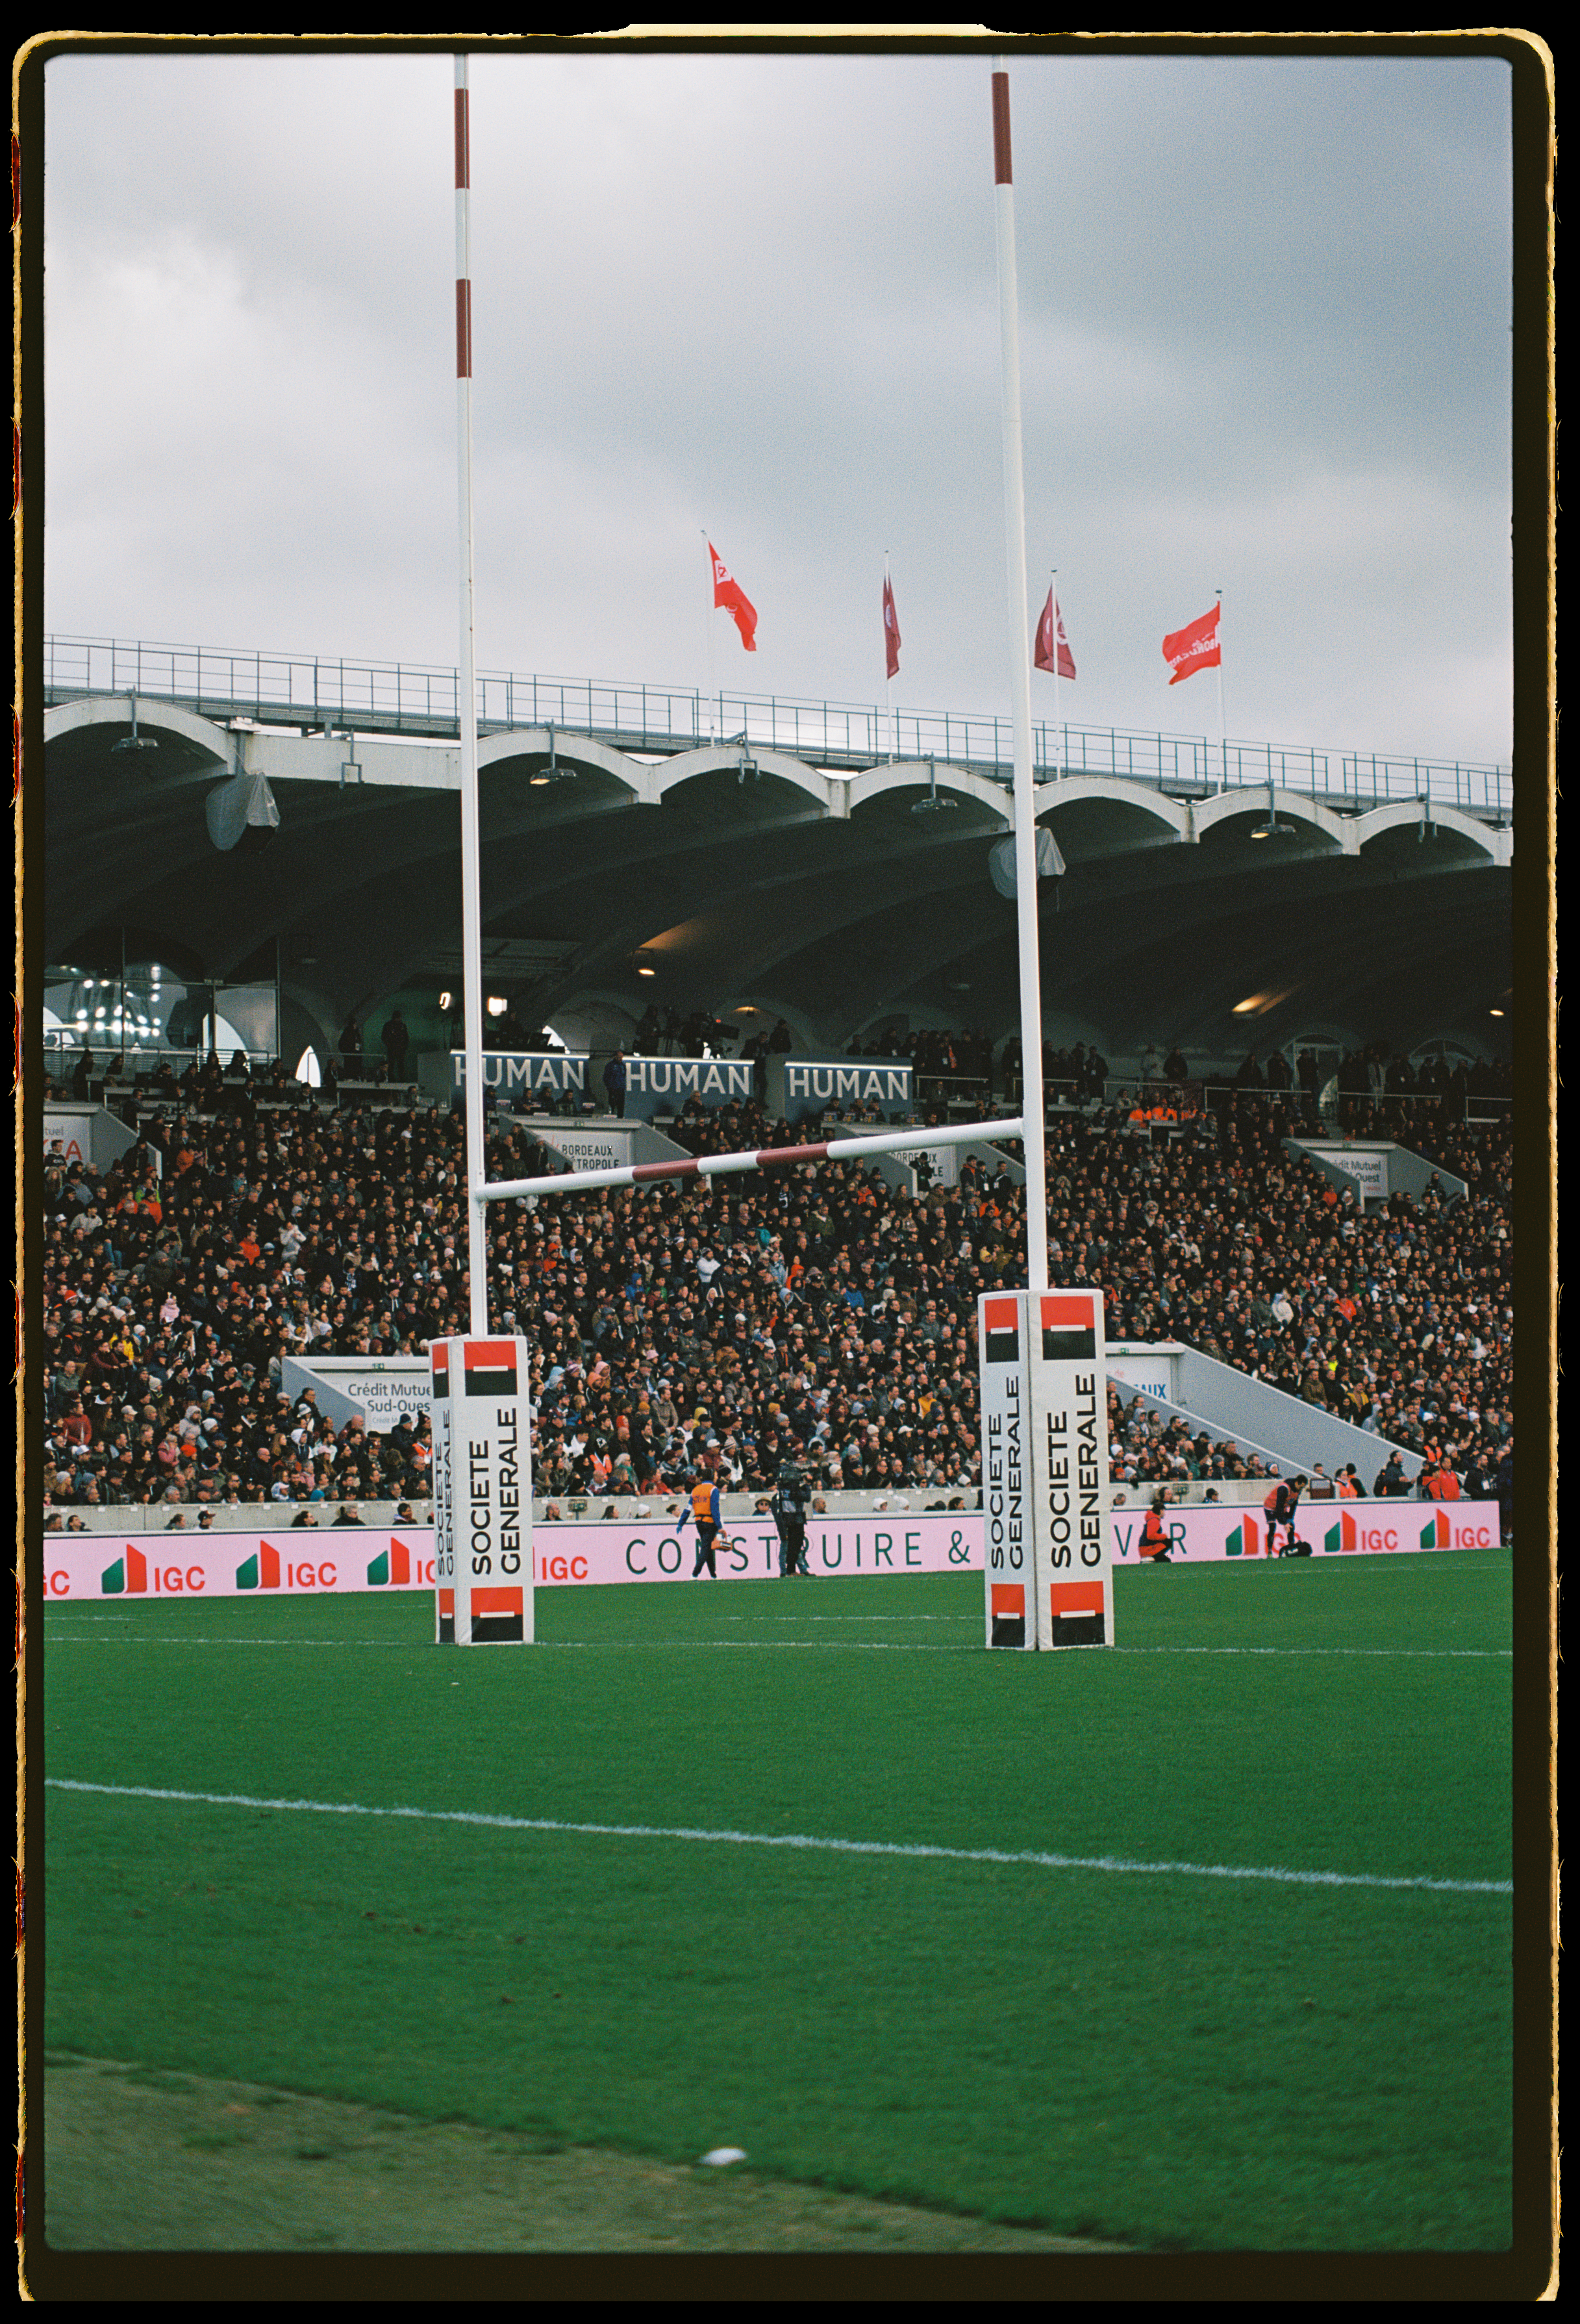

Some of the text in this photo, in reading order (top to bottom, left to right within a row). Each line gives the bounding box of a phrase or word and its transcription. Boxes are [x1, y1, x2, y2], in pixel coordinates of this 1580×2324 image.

[455, 1056, 584, 1090] HUMAN
[625, 1063, 749, 1094] HUMAN
[790, 1068, 908, 1100] HUMAN
[562, 1144, 612, 1156] BORDEAUX
[348, 1383, 431, 1396] Crédit Mutue
[368, 1399, 431, 1412] Sud-Oues
[1006, 1376, 1023, 1570] GENERALE
[1075, 1374, 1101, 1567] GENERALE
[443, 1409, 454, 1576] GENERALE
[497, 1408, 521, 1574] GENERALE
[988, 1413, 1004, 1570] SOCIETE
[1047, 1411, 1072, 1569] SOCIETE
[435, 1442, 445, 1576] SOCIETE
[469, 1440, 492, 1575] SOCIETE
[948, 1530, 971, 1564] &
[1361, 1529, 1398, 1551] IGC
[1455, 1527, 1490, 1548] IGC
[155, 1566, 205, 1592] IGC
[288, 1562, 337, 1587] IGC
[542, 1556, 588, 1580] IGC
